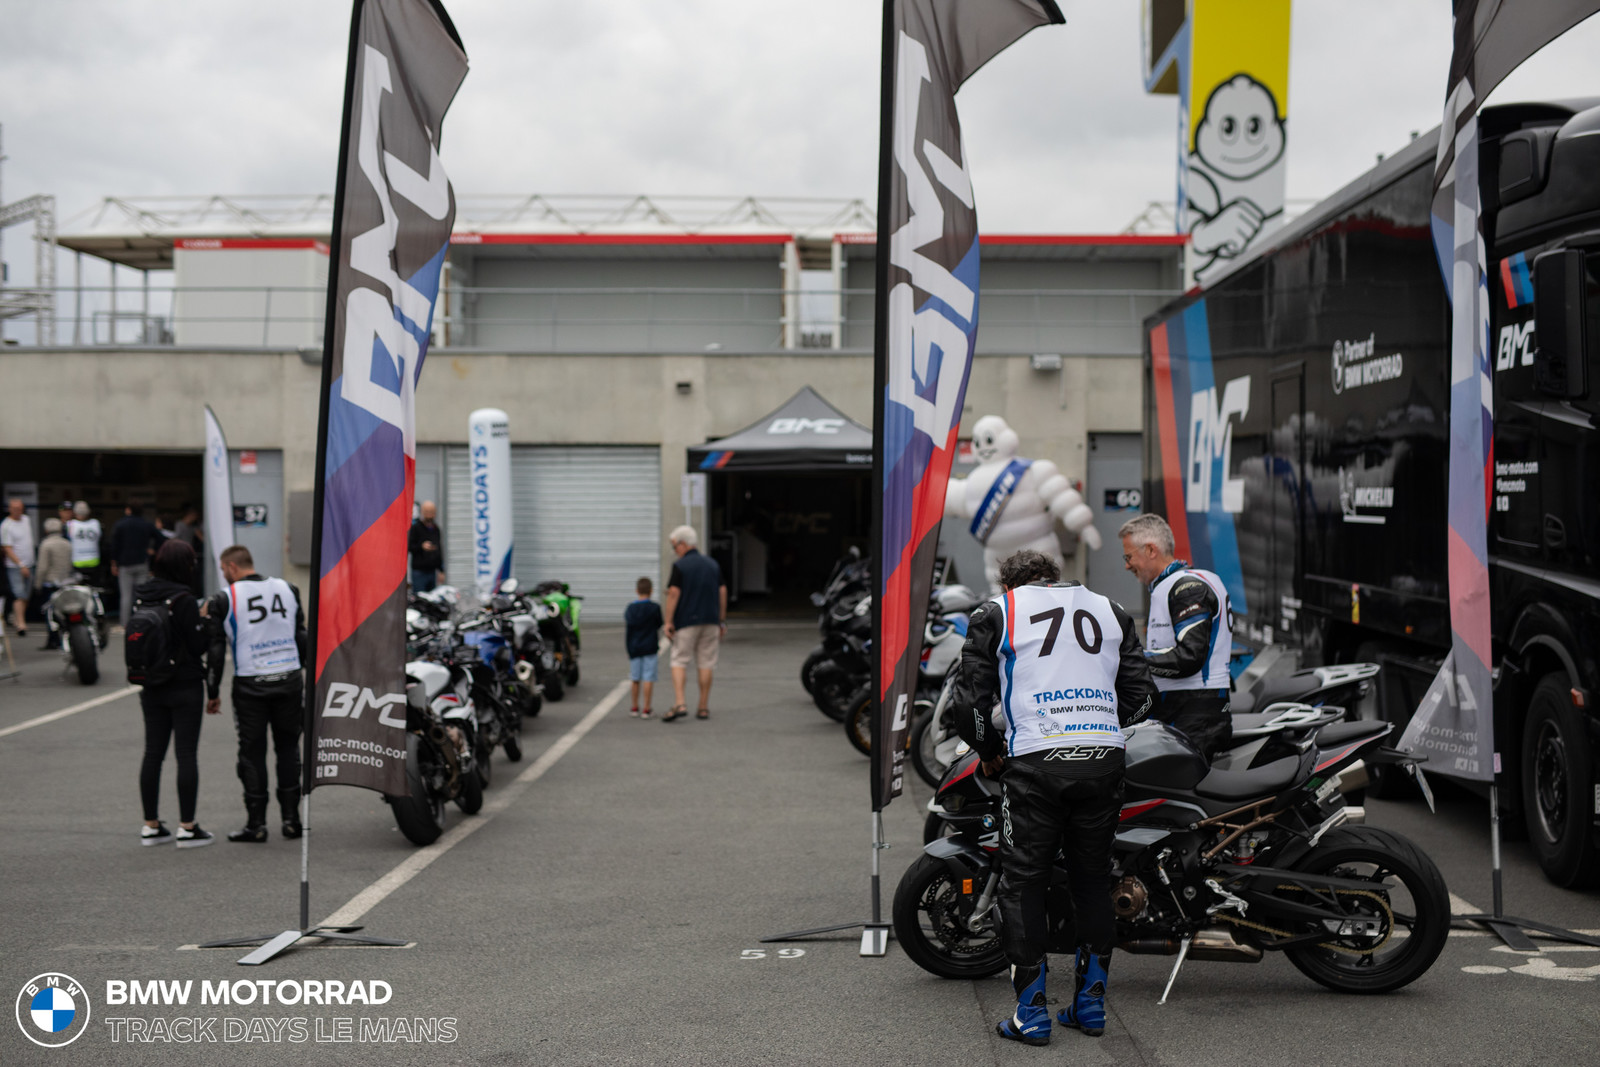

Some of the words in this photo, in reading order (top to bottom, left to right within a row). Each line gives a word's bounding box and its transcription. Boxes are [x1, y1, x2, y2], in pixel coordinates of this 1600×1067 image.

[1496, 319, 1536, 371] BMC
[1362, 352, 1403, 386] MOTORRAD
[767, 418, 846, 435] BMC
[1186, 374, 1251, 513] BMC
[1116, 489, 1142, 507] 60
[1355, 486, 1395, 508] MICHELIN
[244, 505, 267, 523] 57
[474, 444, 490, 579] TRACKDAYS
[247, 594, 288, 624] 54
[1030, 607, 1103, 659] 70
[322, 682, 407, 729] BMC
[1033, 688, 1114, 704] TRACKDAYS
[1050, 706, 1074, 715] BMW
[1076, 705, 1115, 715] MOTORRAD
[1064, 723, 1118, 733] MICHELIN
[1043, 745, 1116, 761] RST
[740, 948, 806, 960] 59
